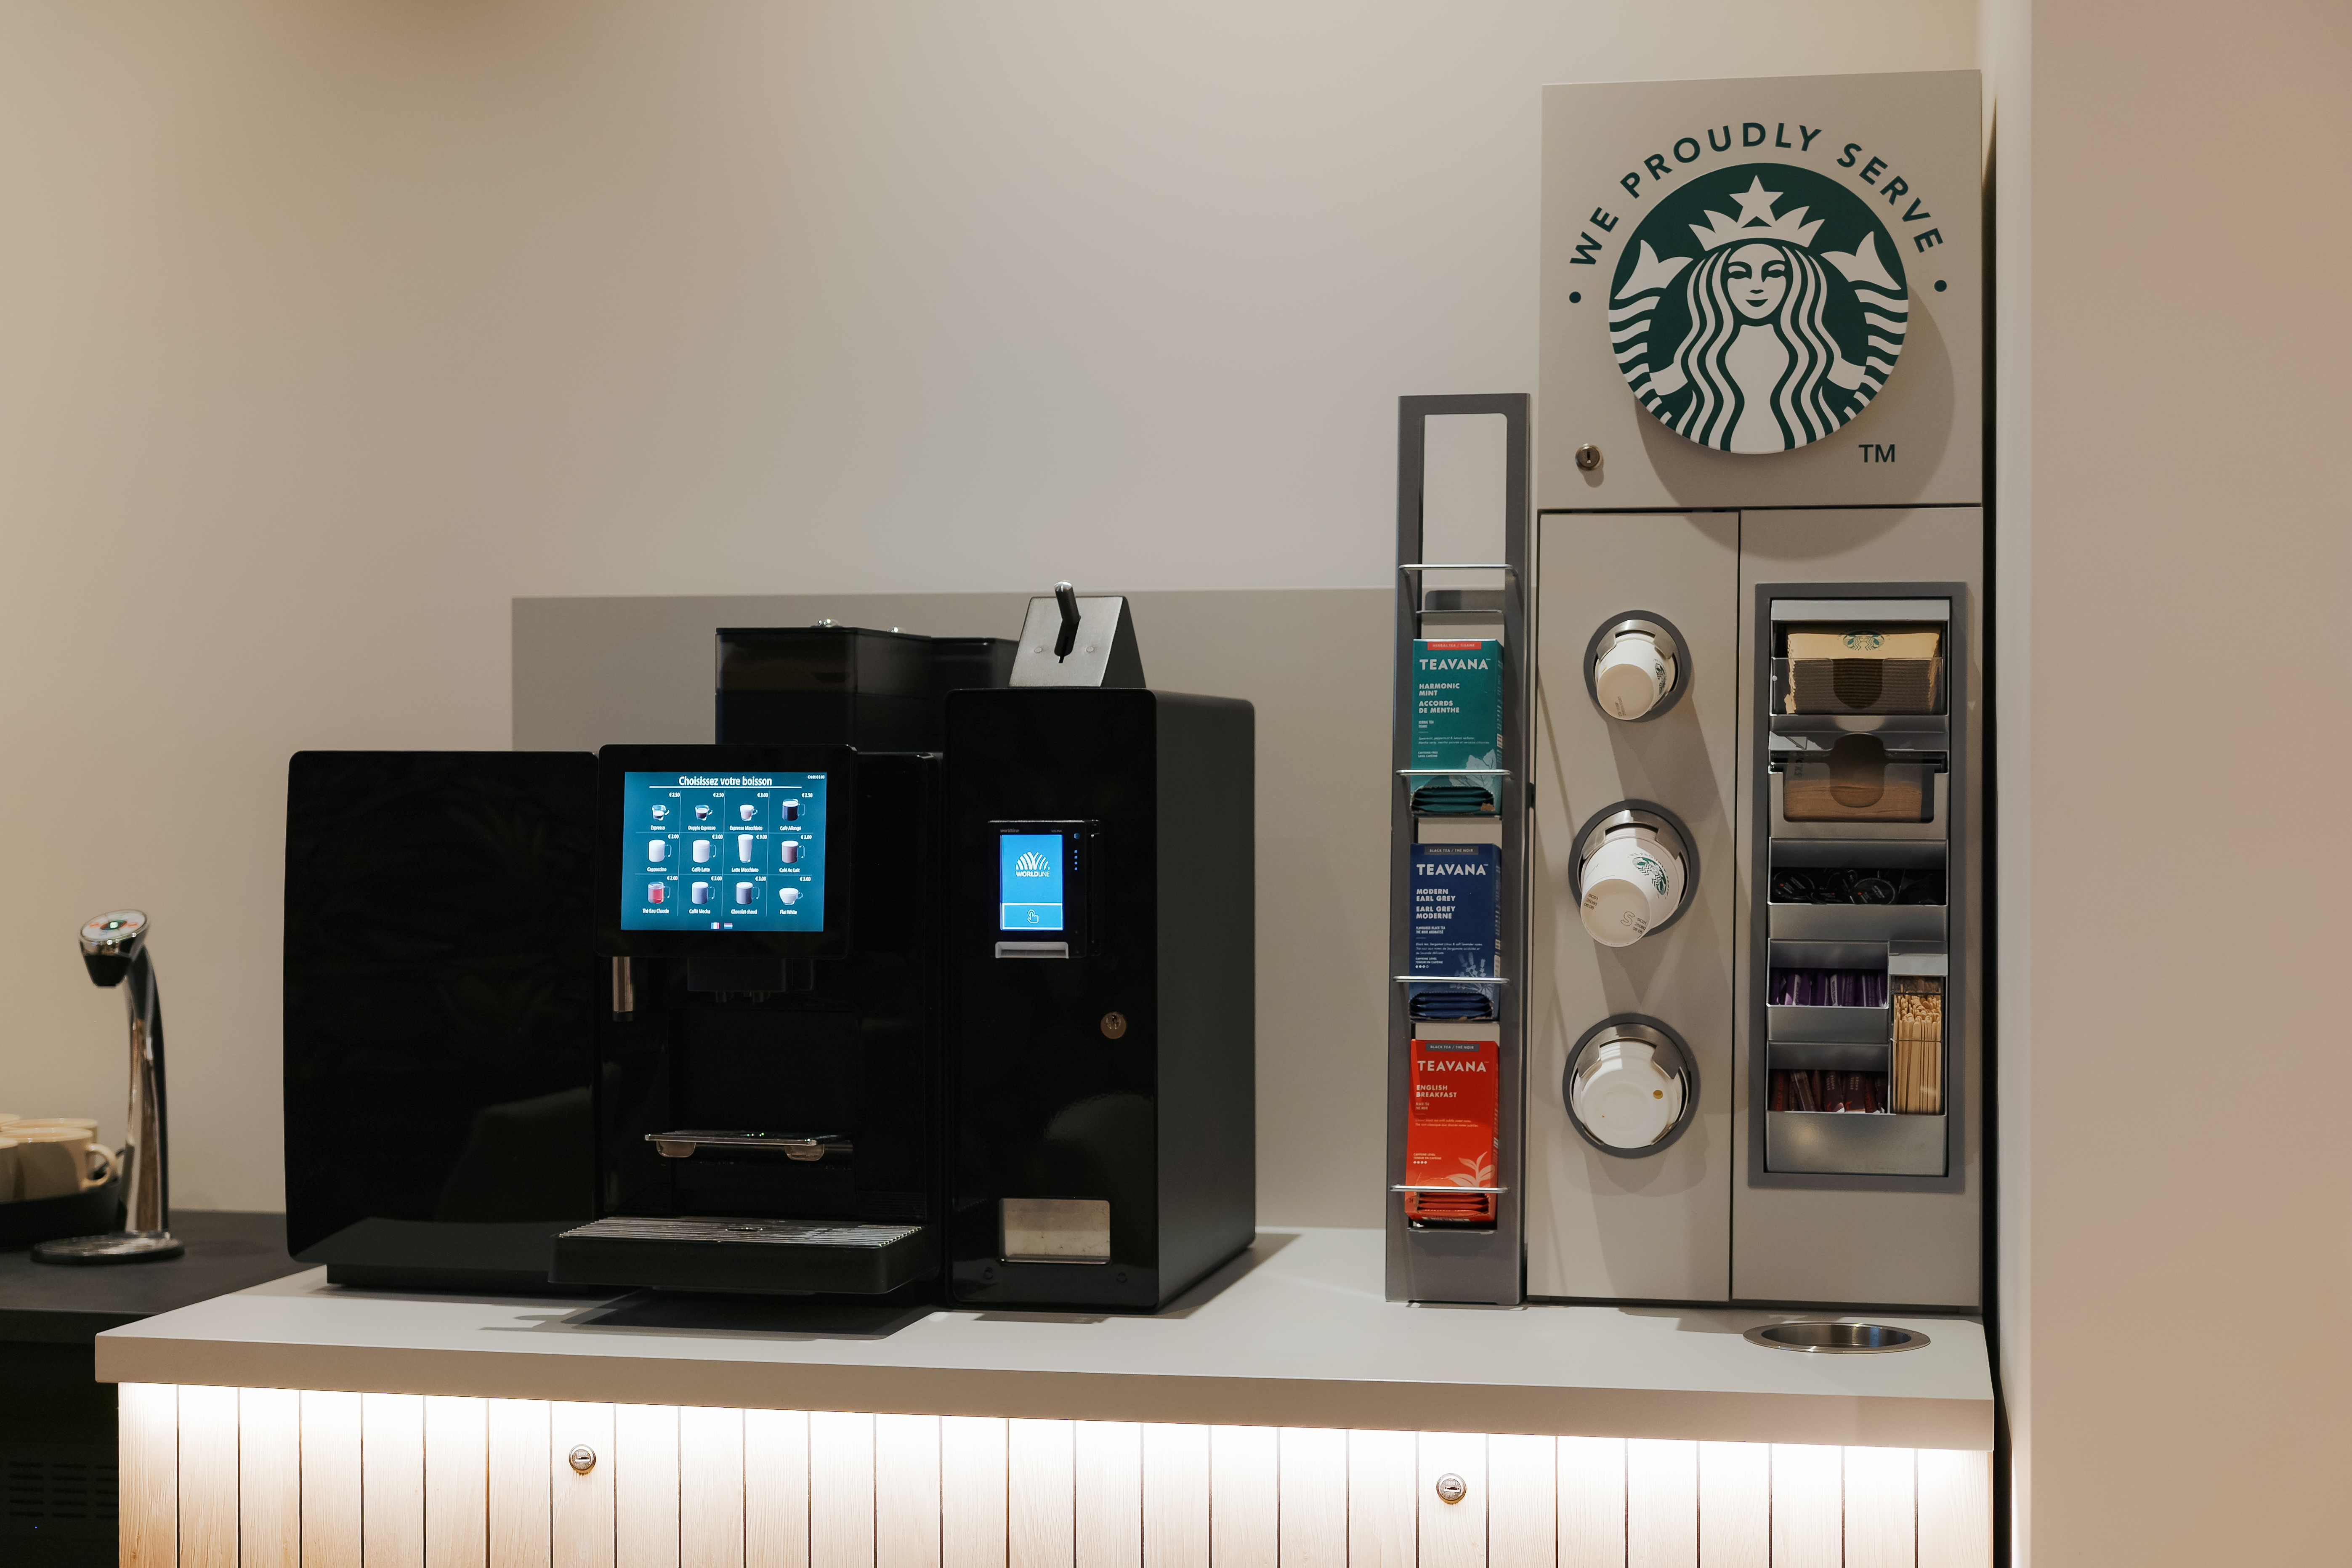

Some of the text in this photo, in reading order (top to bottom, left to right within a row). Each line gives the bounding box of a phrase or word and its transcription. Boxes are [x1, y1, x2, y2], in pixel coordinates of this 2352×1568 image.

[1569, 122, 1944, 266] WE PROUDLY SERVE
[1858, 443, 1896, 463] TM
[1419, 659, 1488, 670] TEAVANA
[678, 776, 772, 786] Choisissez votre boisson
[1416, 864, 1486, 875] TEAVANA
[1620, 911, 1635, 927] S
[1417, 1060, 1487, 1072] TEAVANA
